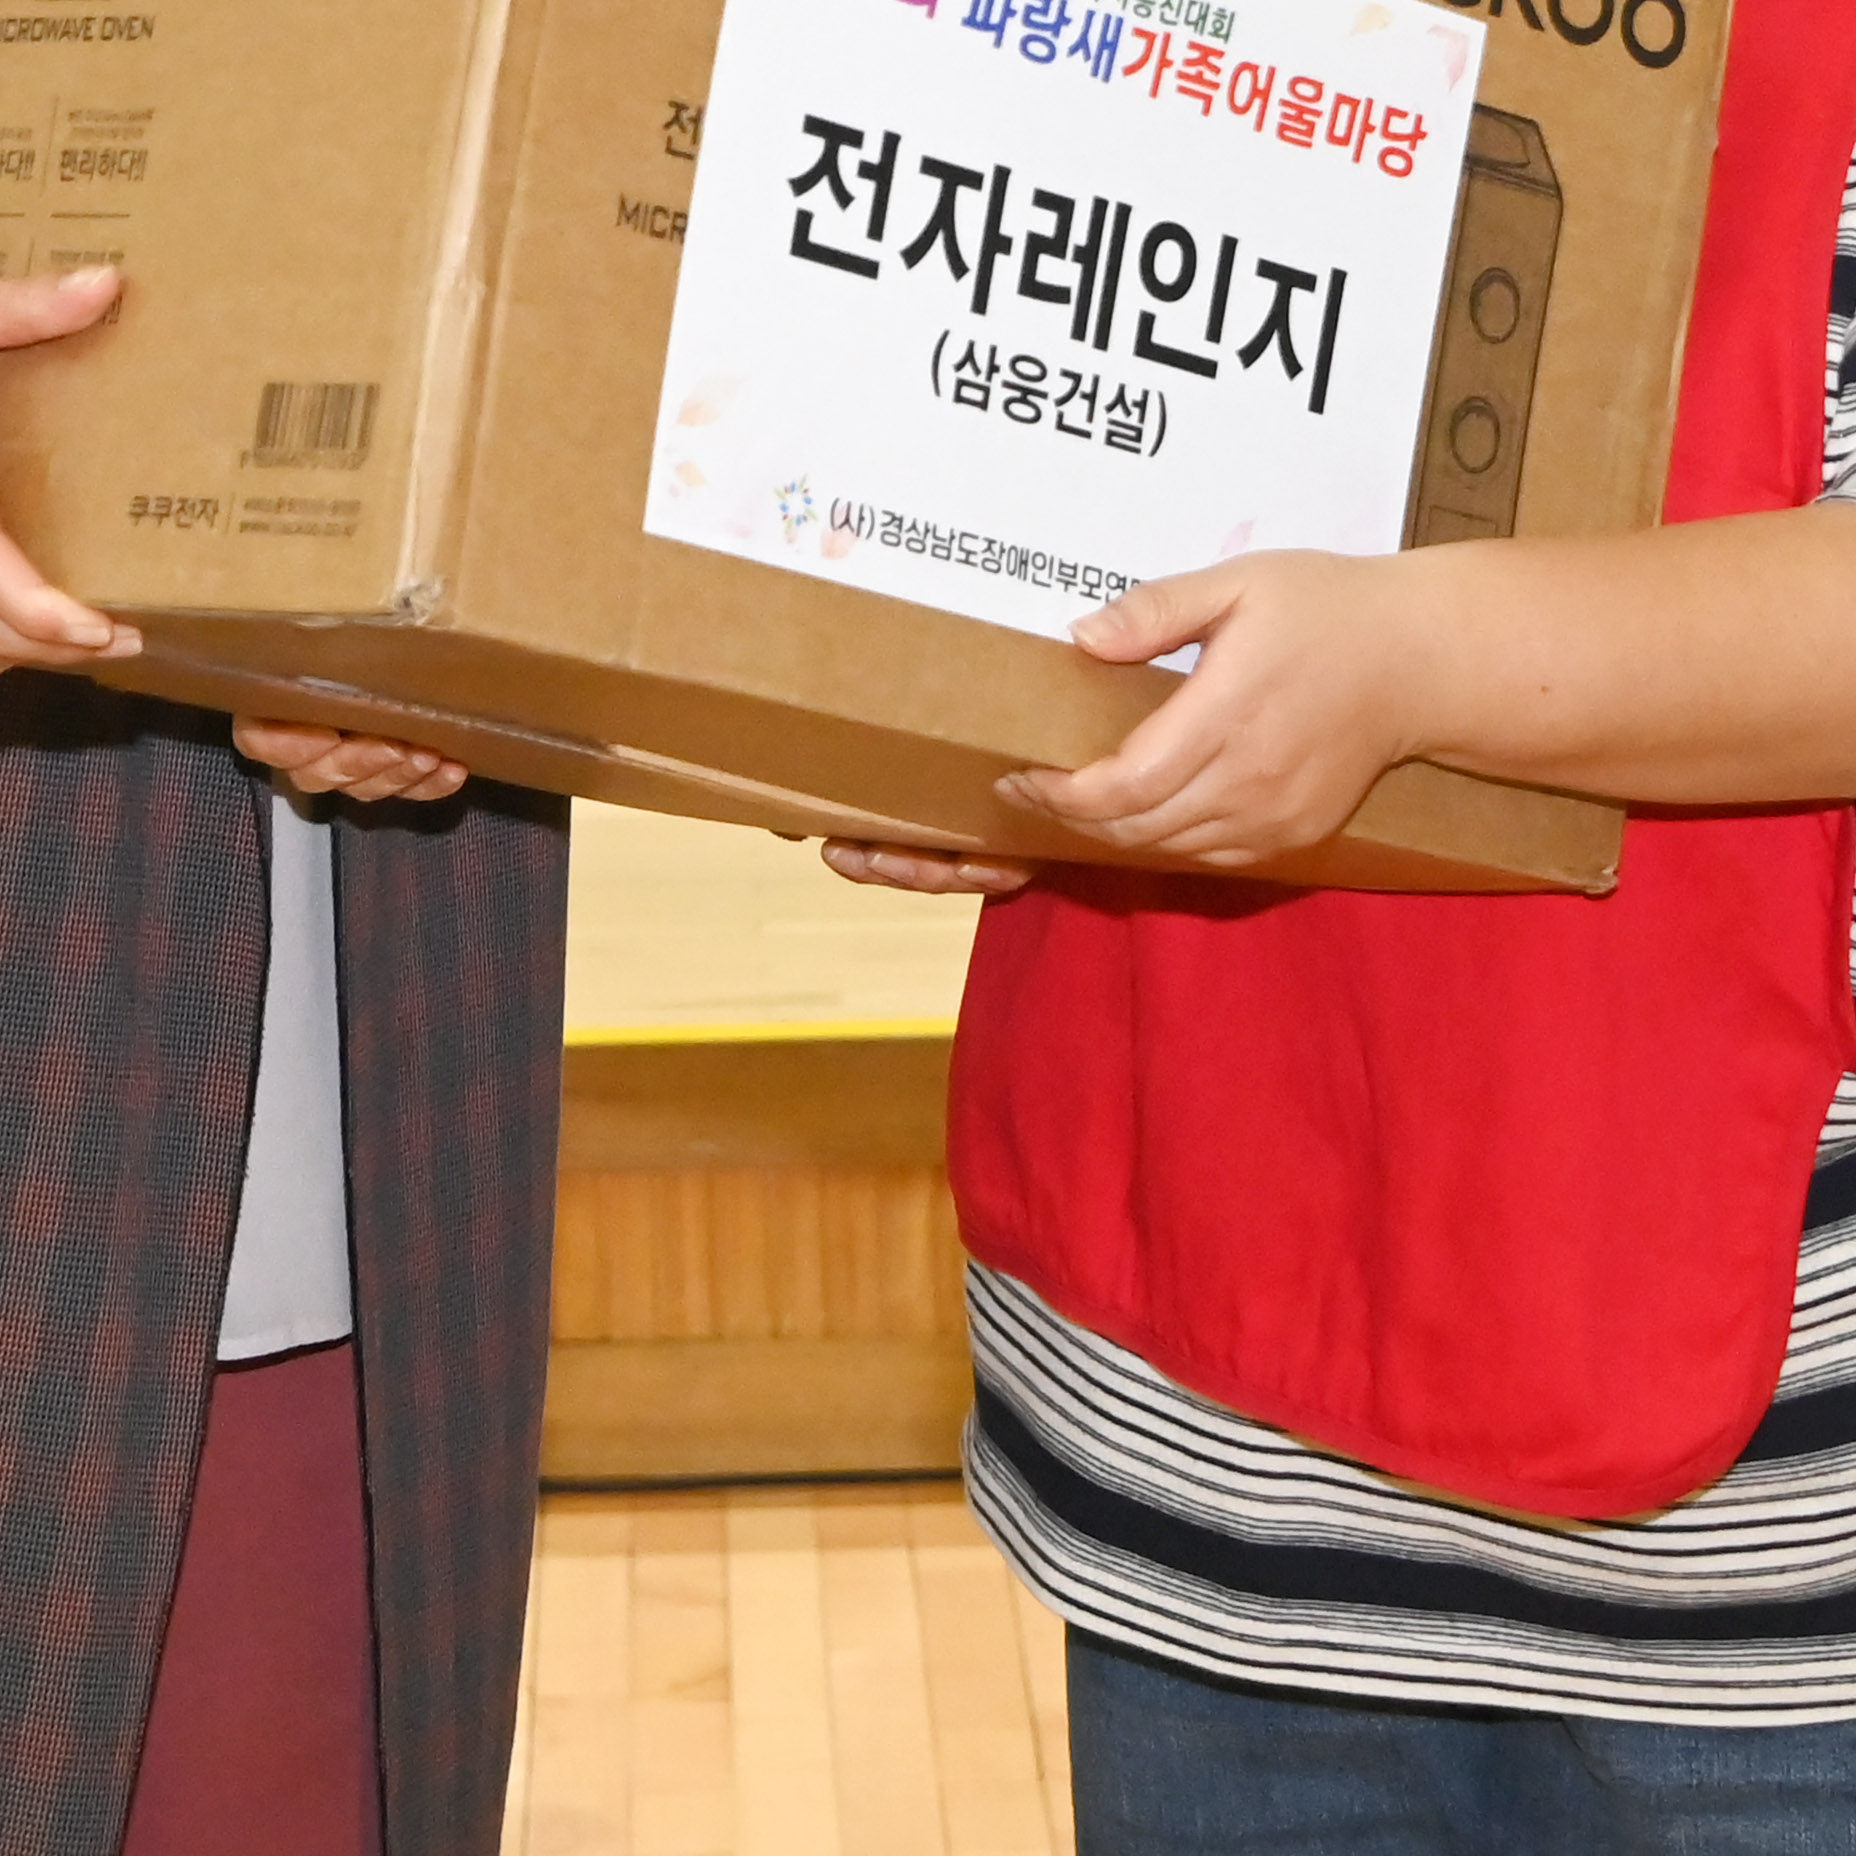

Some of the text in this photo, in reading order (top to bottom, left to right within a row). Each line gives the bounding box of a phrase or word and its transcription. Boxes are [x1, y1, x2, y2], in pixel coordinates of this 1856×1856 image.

[100, 15, 156, 42] OVEN
[785, 113, 1350, 416] 전자레인지
[928, 329, 1169, 459] (삼웅건설)
[128, 495, 220, 530] 쿠쿠전자
[829, 496, 1146, 606] (사)경상남도장애인부모연
